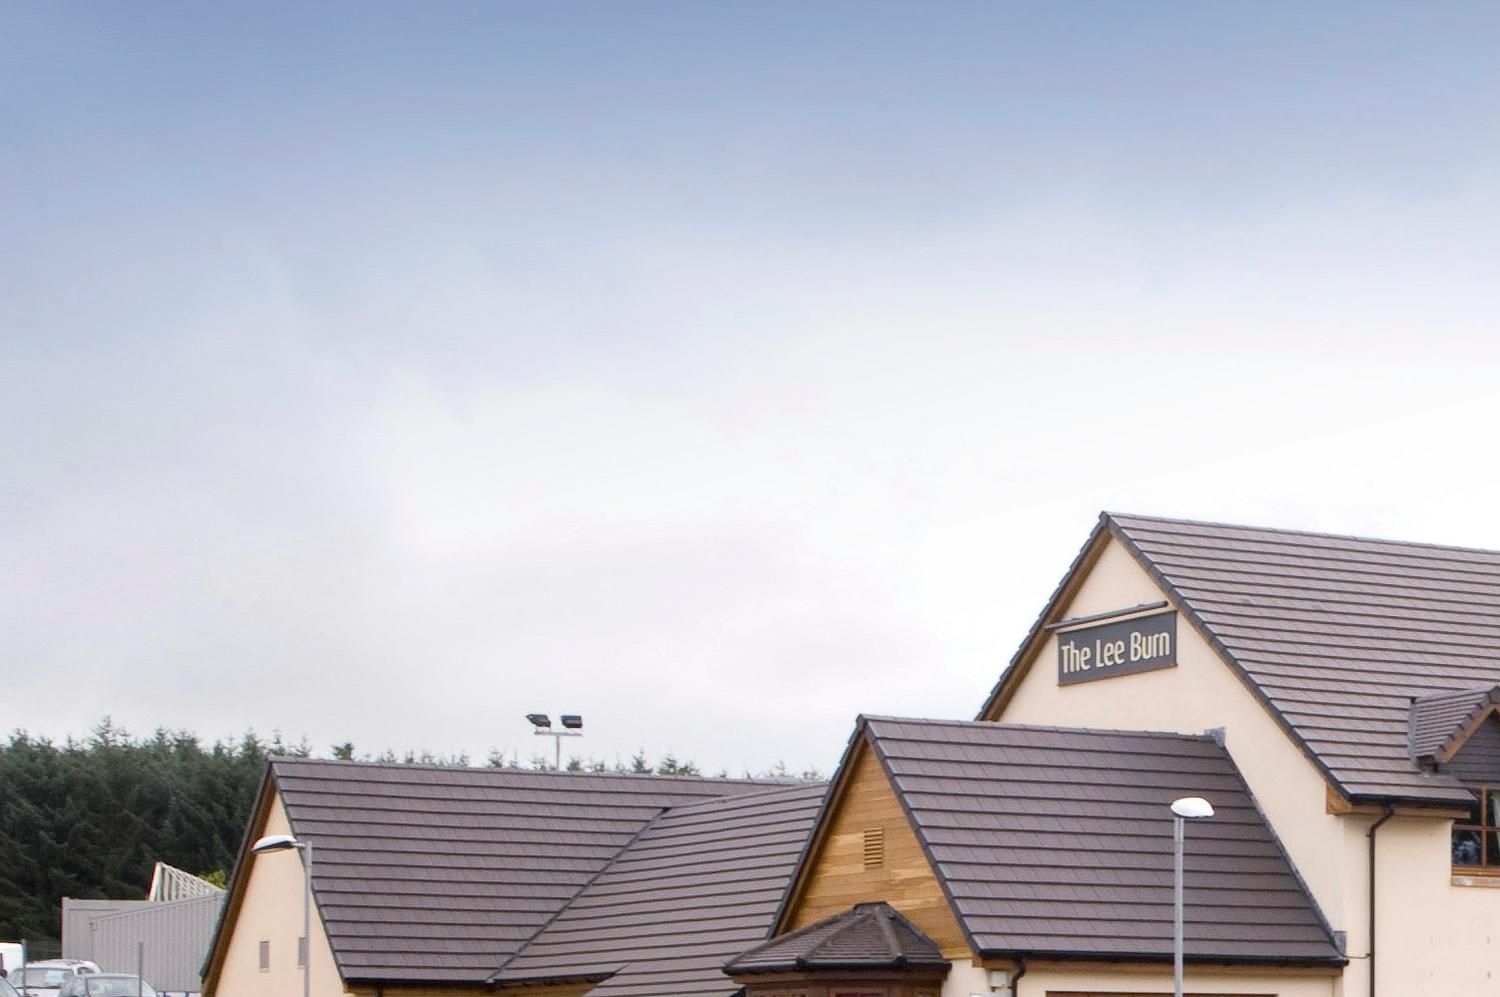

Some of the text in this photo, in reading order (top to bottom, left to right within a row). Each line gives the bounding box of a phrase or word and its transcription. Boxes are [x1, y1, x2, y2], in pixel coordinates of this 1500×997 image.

[1061, 631, 1170, 674] The Lee Burn
